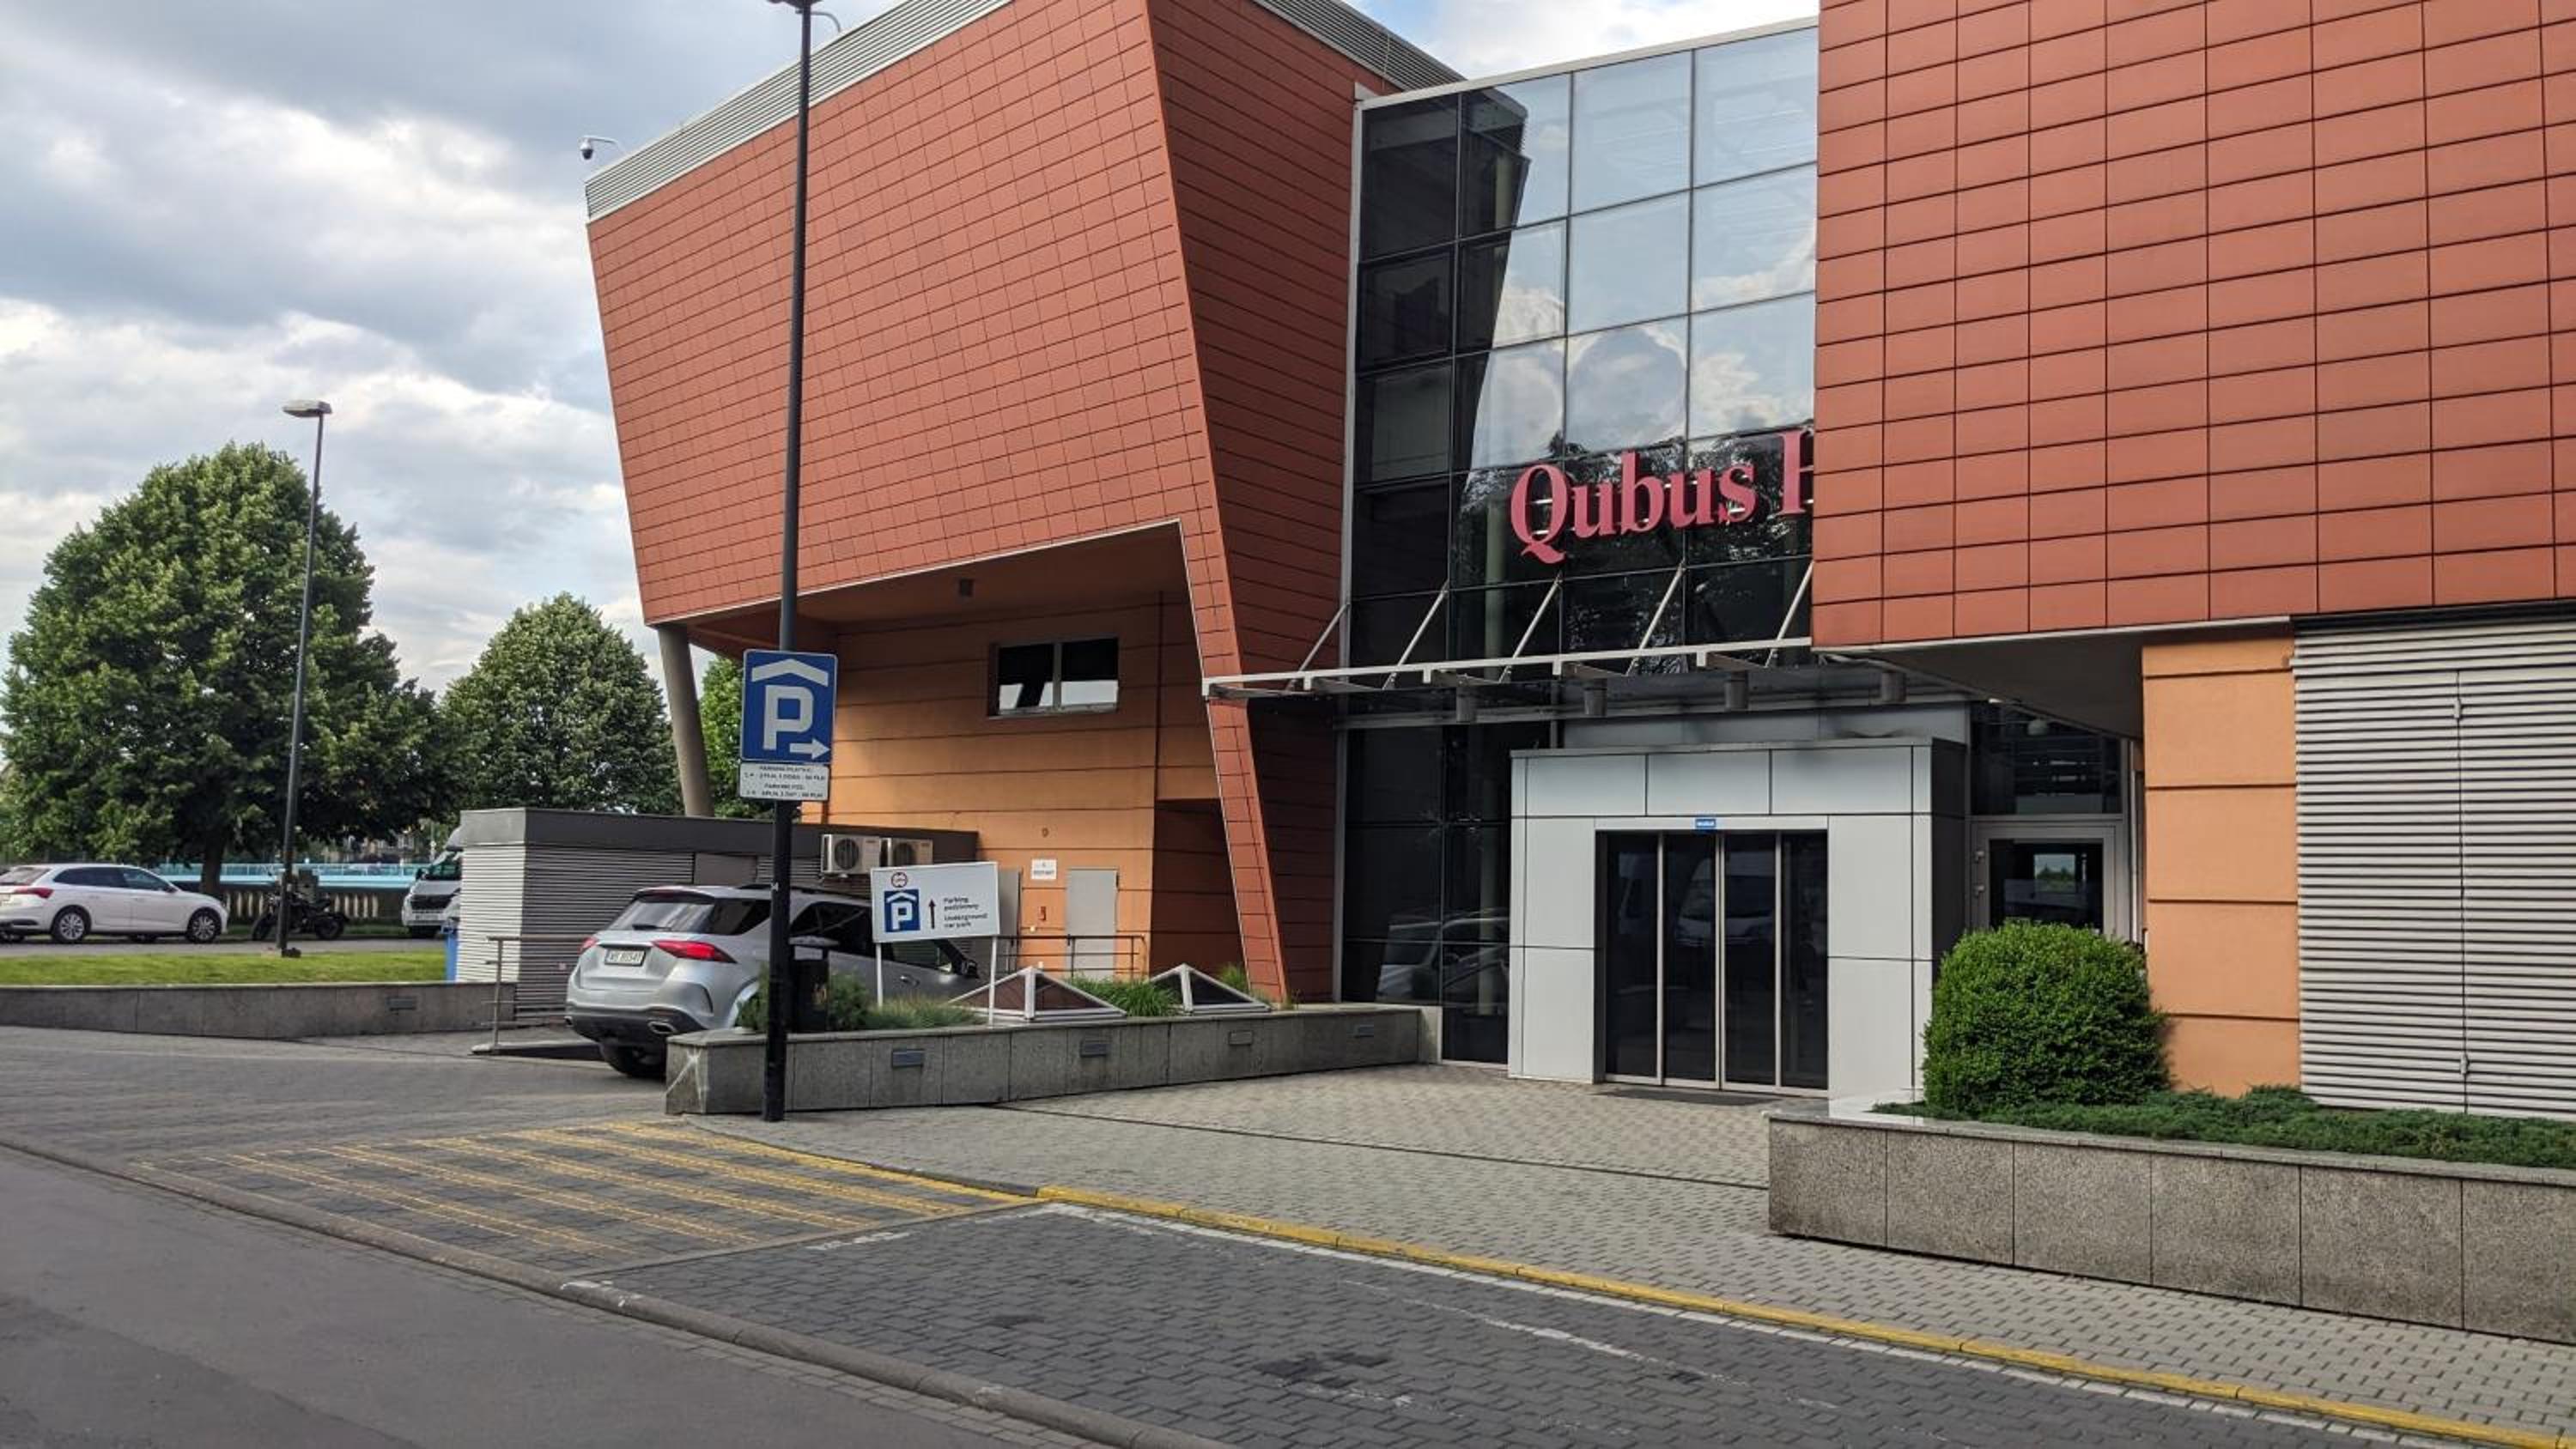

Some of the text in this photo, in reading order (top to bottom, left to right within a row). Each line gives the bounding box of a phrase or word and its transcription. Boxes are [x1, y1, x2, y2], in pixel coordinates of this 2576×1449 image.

[1510, 449, 1756, 564] Qubus
[762, 685, 814, 750] P
[890, 901, 913, 931] P
